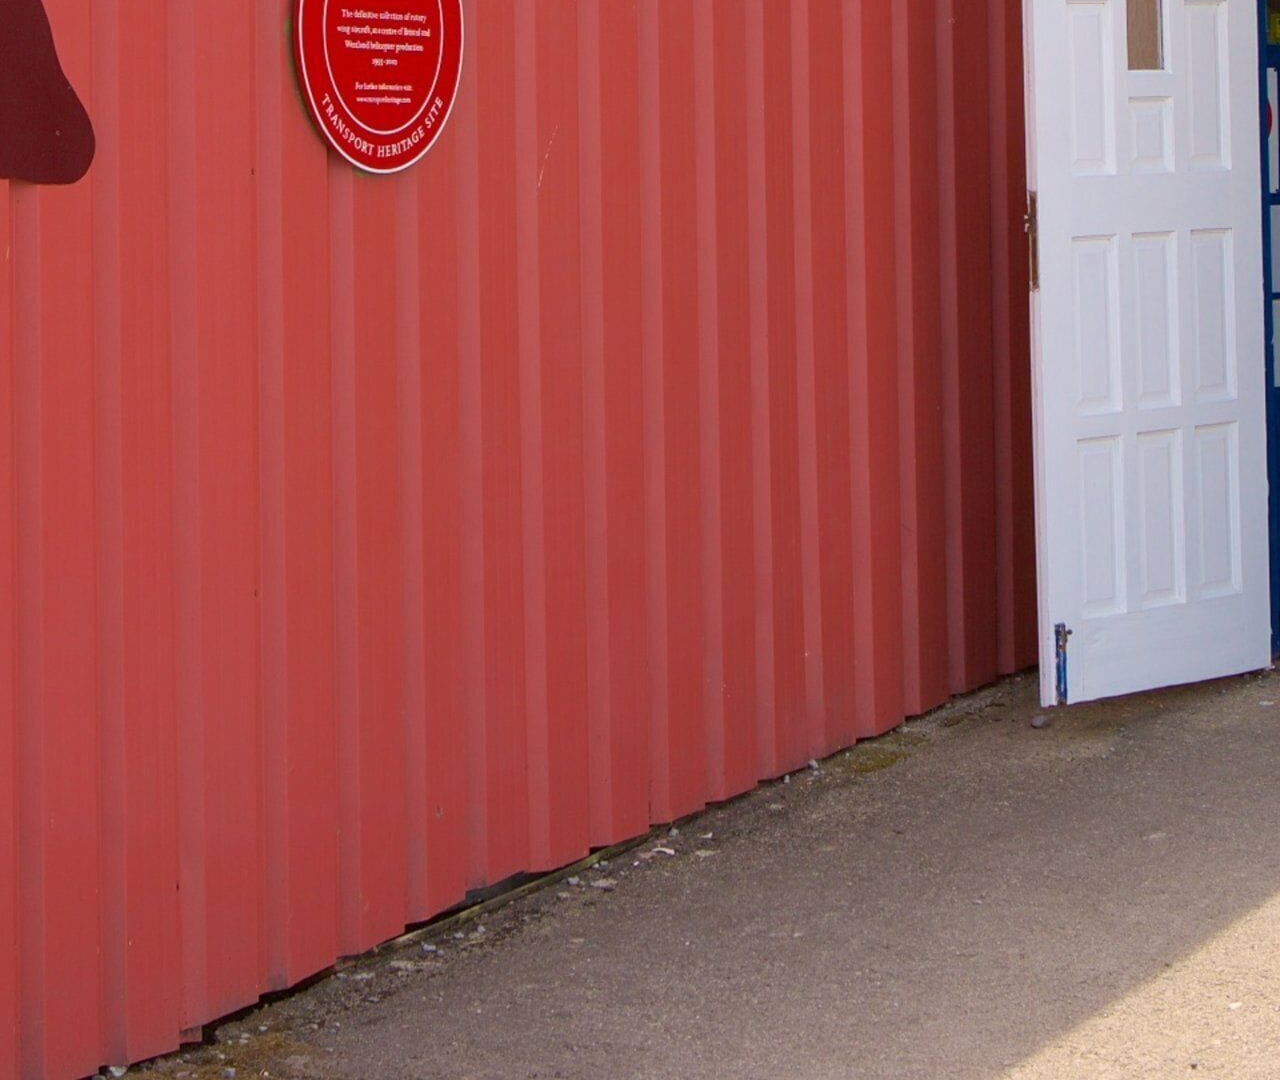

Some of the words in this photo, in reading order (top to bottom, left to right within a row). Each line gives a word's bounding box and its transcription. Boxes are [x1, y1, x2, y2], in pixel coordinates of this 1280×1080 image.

[341, 8, 353, 18] The
[322, 93, 374, 156] TRANSPORT
[377, 128, 425, 158] HERITAGE
[425, 96, 444, 129] SITE
